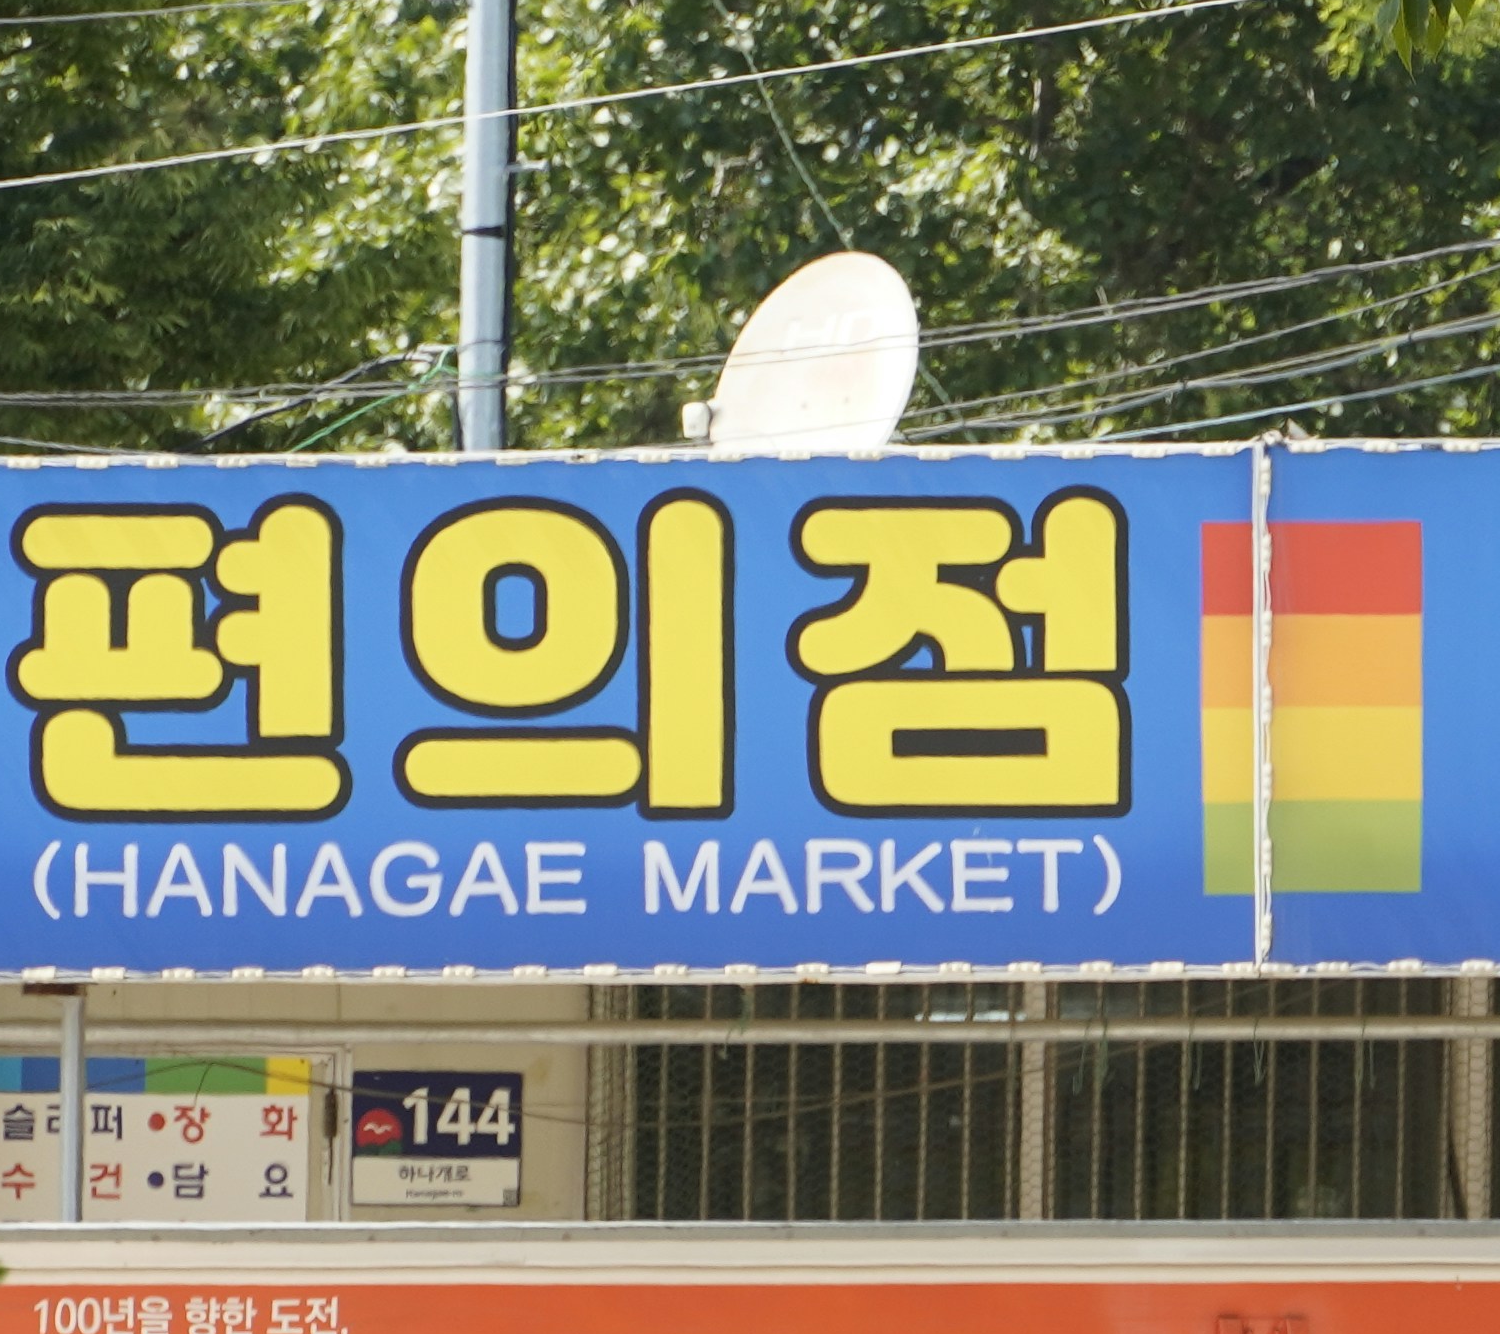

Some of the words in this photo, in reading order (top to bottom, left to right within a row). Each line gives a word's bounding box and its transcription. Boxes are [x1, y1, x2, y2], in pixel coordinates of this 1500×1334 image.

[7, 485, 1131, 822] 편의점
[34, 840, 587, 919] (HANAGAE
[643, 835, 1122, 915] MARKET)
[402, 1087, 516, 1146] 144
